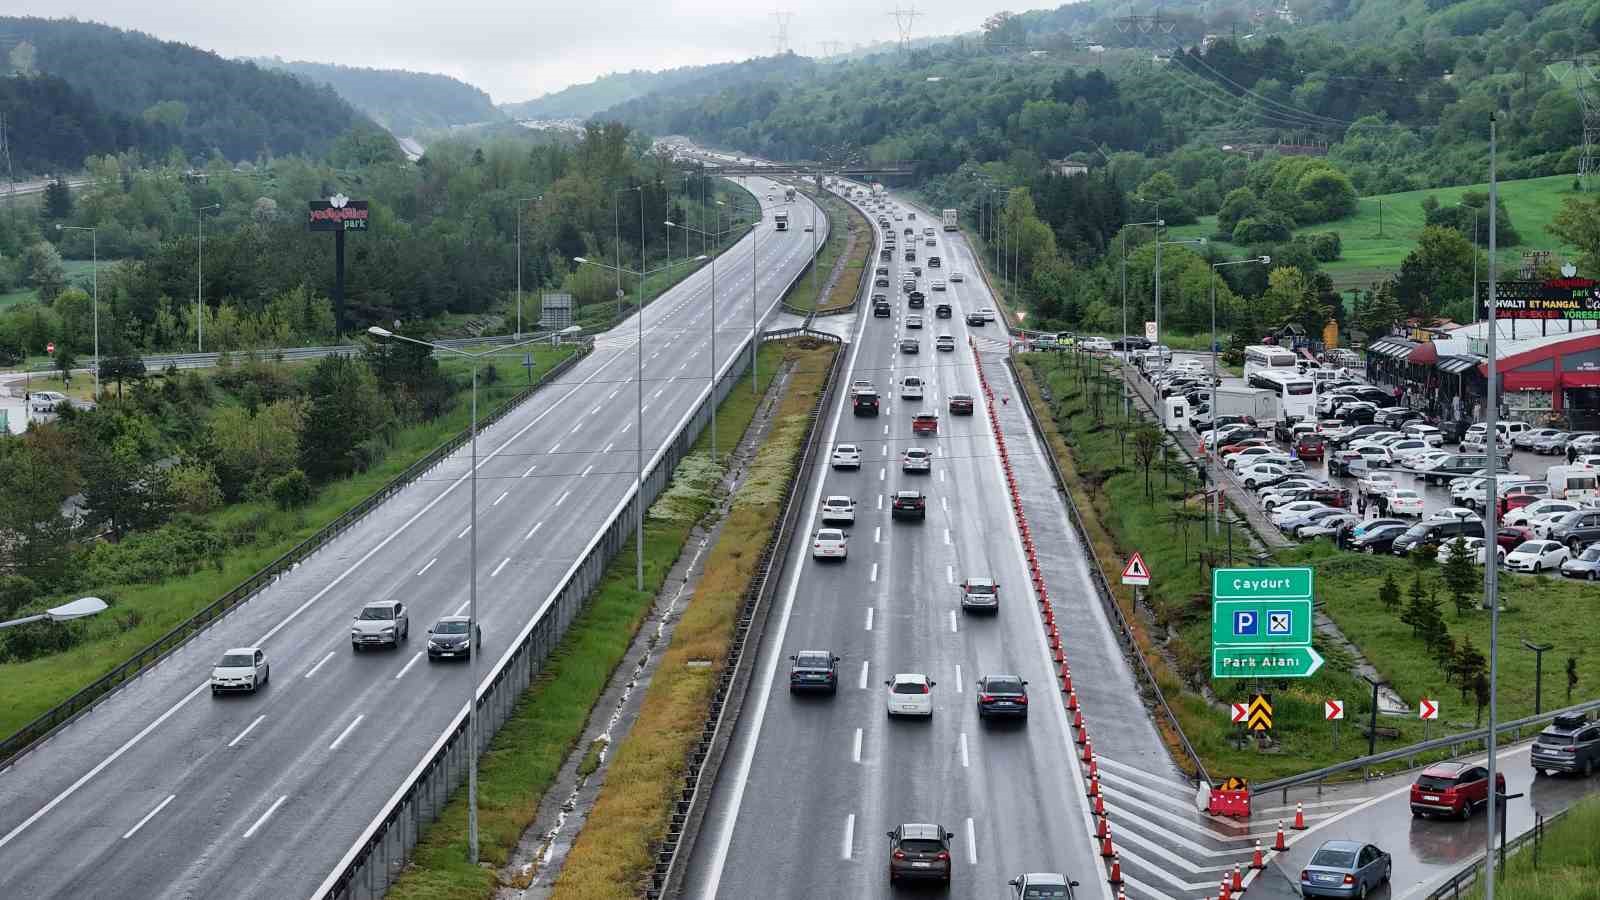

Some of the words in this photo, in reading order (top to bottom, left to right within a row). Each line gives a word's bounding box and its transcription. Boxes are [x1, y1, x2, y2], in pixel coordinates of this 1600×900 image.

[344, 219, 367, 230] park
[1572, 287, 1589, 299] park
[1484, 300, 1526, 308] KHVALTI
[1529, 300, 1541, 308] ET
[1542, 300, 1580, 308] MANGAL
[1563, 309, 1600, 319] YÖRESE
[1233, 579, 1290, 591] Çaydurt
[1238, 612, 1253, 633] P
[1223, 657, 1256, 667] Park
[1262, 657, 1299, 667] Alanı
